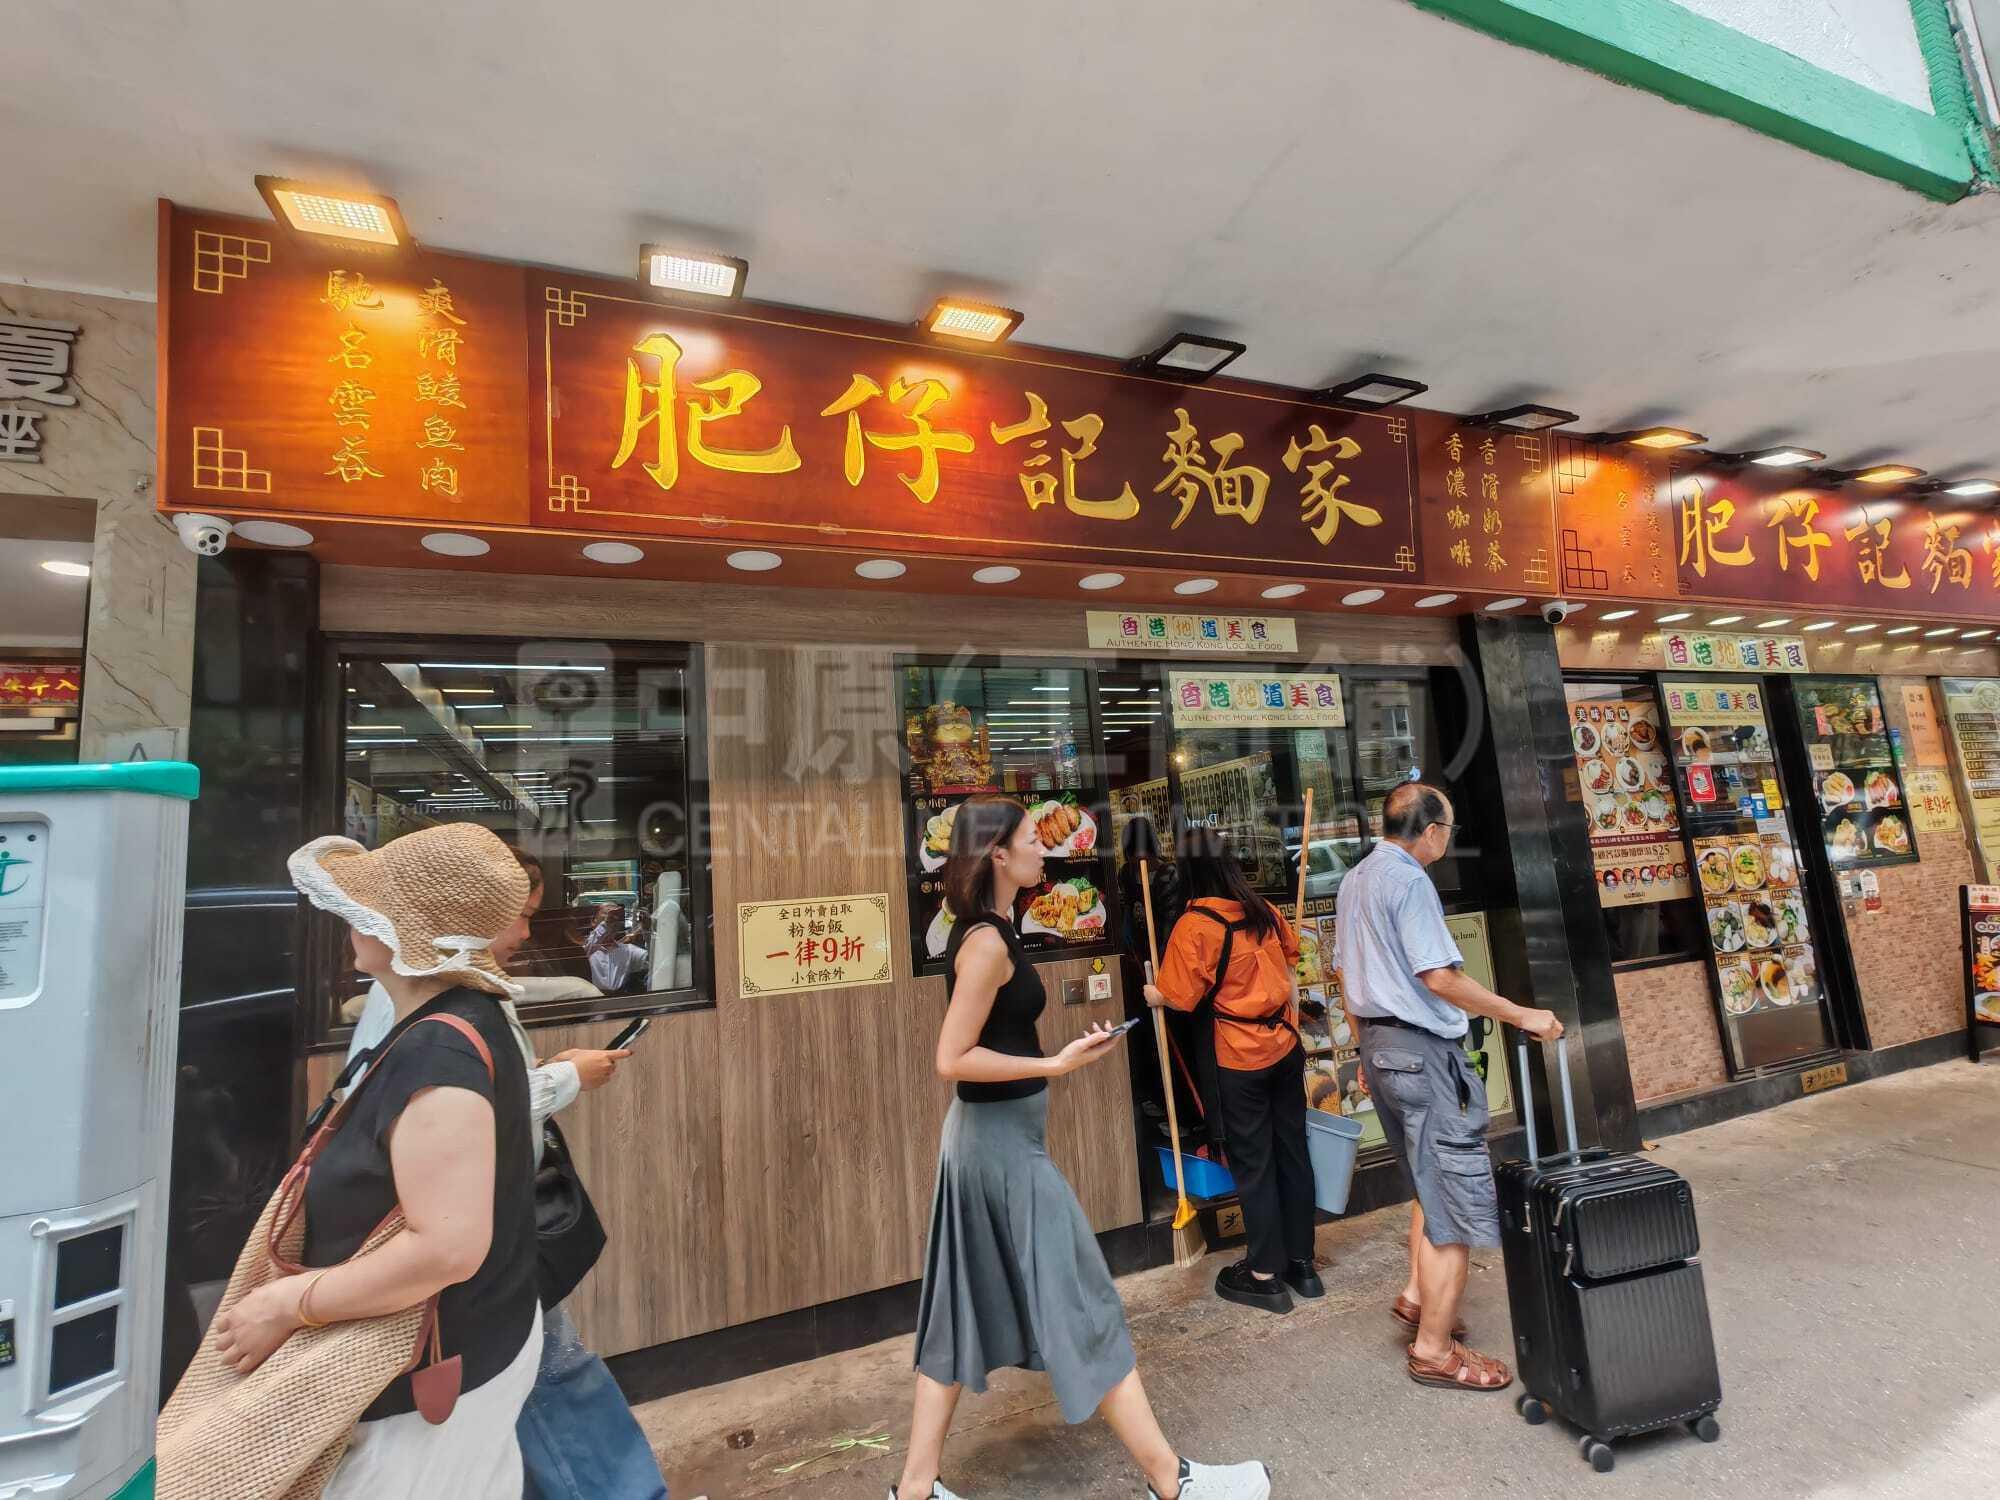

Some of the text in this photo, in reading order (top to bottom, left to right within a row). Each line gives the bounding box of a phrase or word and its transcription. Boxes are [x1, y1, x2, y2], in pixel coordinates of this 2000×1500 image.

[611, 332, 1384, 547] 肥仔記麵家
[1445, 432, 1473, 569] 香濃咖啡
[1479, 437, 1508, 573] 香滑奶茶
[1679, 478, 2000, 595] 肥仔記麵
[1121, 616, 1268, 640] 香港地道美食
[1106, 637, 1283, 650] AUTHENTIC HONG KONG LOCAL FOOD
[1180, 680, 1336, 709] 香港地道美食
[1180, 713, 1340, 723] AUTHENTIC HONG KONG LOCAL FOOD
[788, 918, 845, 938] 粉麵飯
[765, 935, 865, 969] 一律9折
[791, 966, 845, 985] 小食除外
